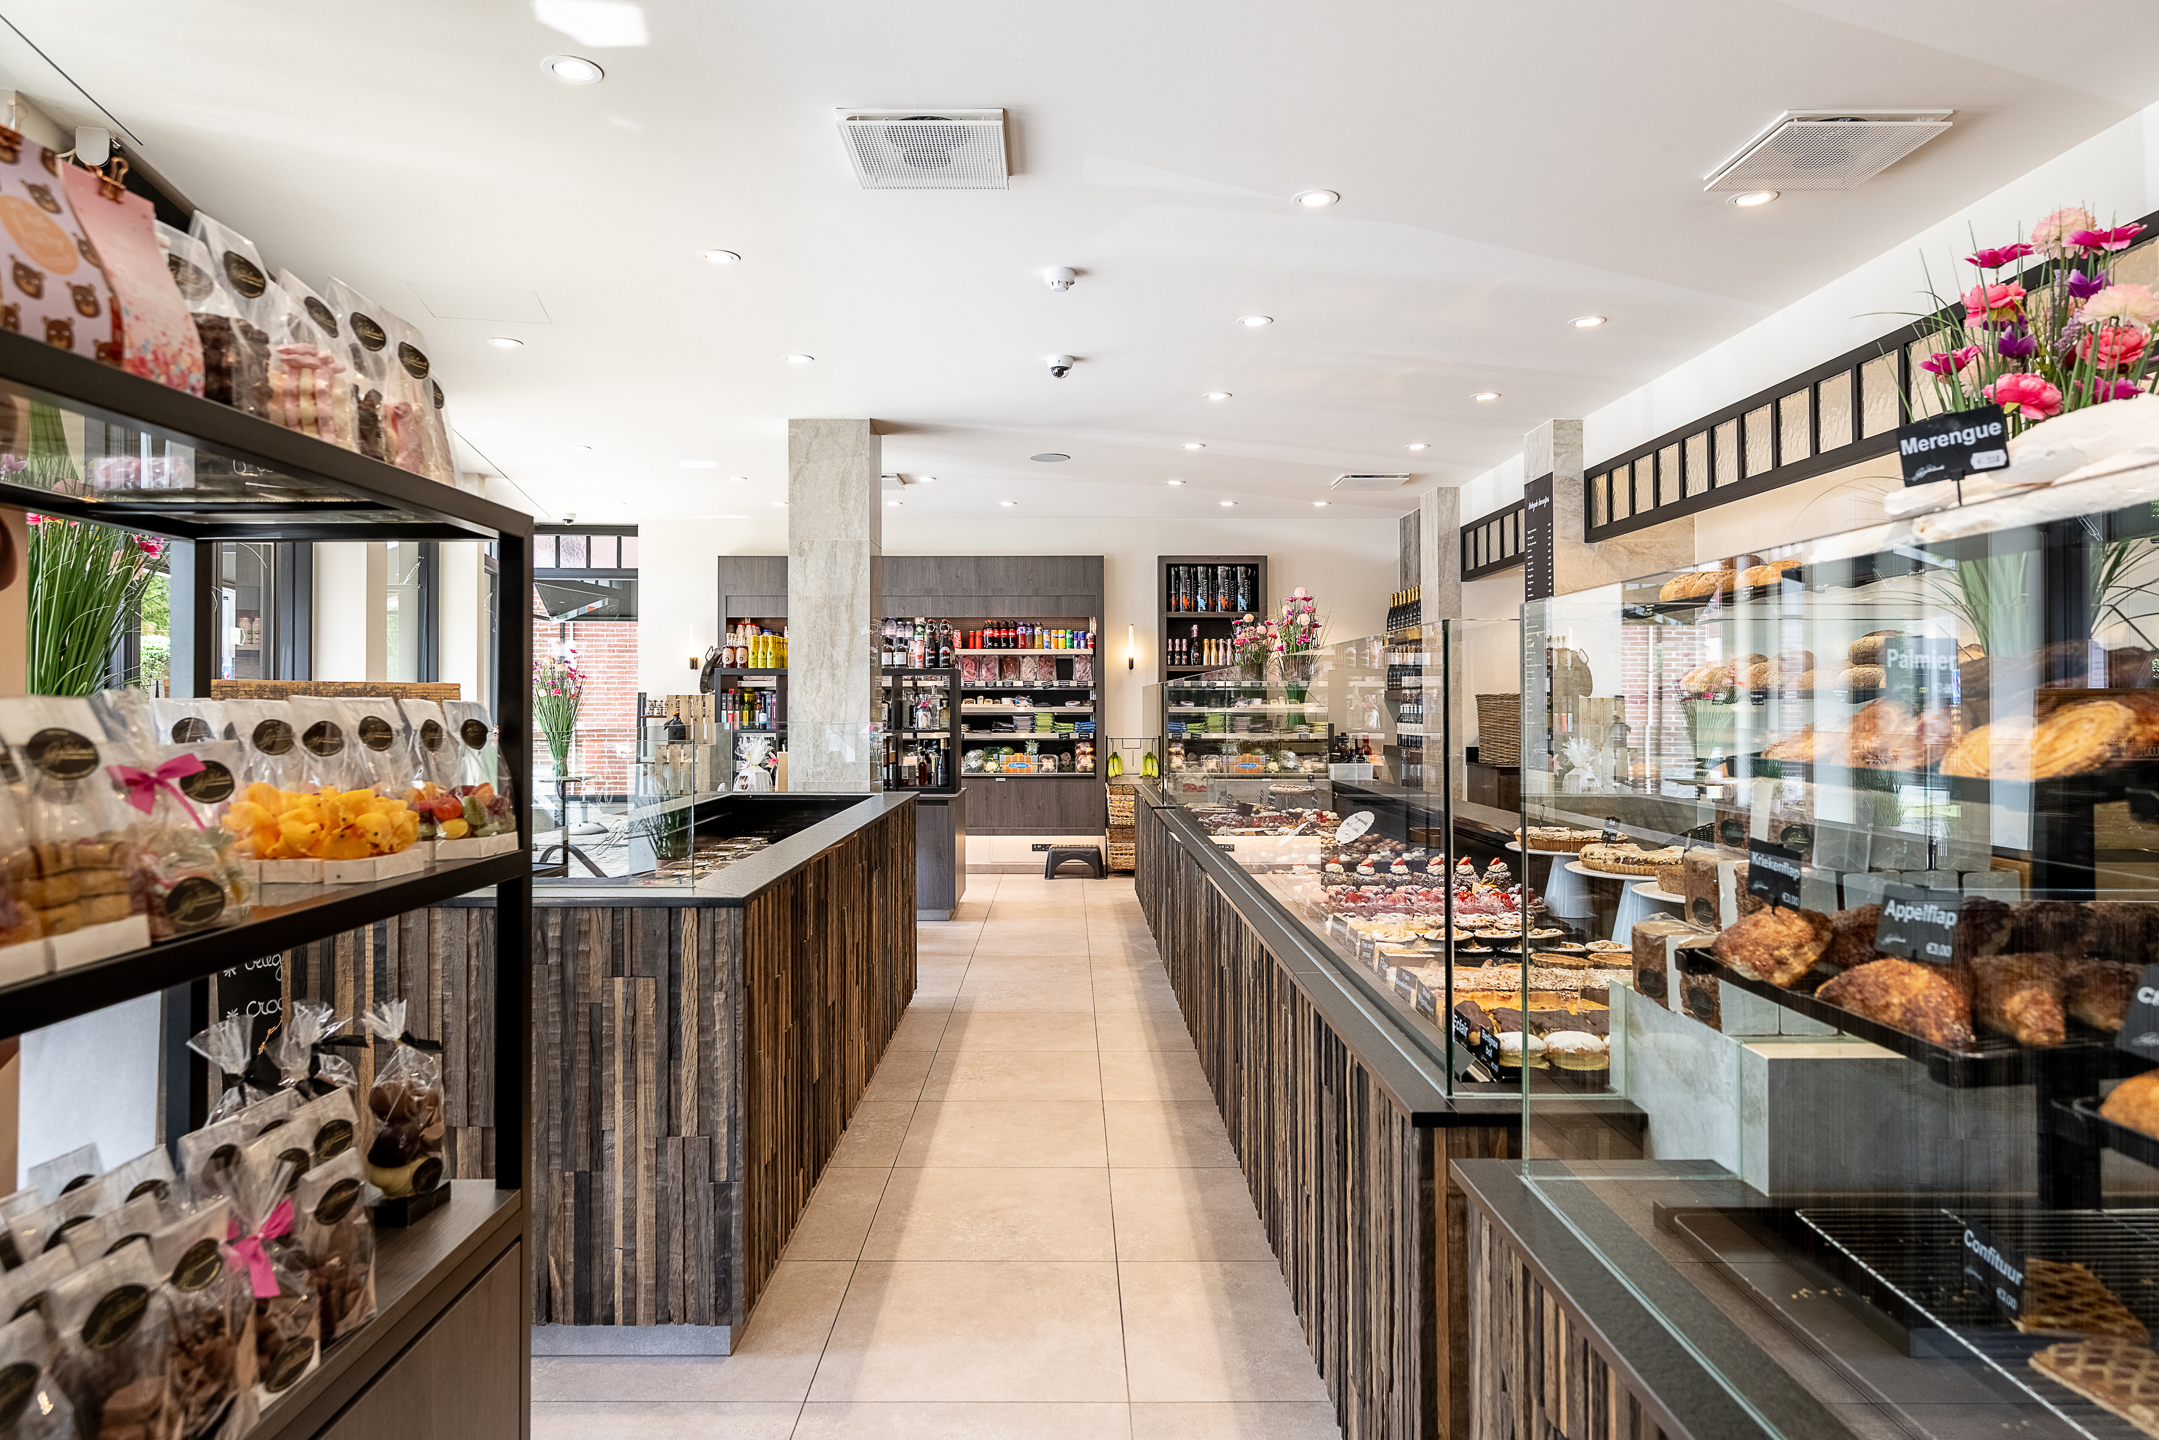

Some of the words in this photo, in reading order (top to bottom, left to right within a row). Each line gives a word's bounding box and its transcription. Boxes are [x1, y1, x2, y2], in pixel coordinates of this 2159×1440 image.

[1900, 421, 2002, 456] Merengue
[1886, 648, 1957, 670] Palmier
[1751, 851, 1801, 881] Kriekenflap
[1883, 899, 1958, 930] Appelflap
[1963, 1228, 2024, 1287] Confituur
